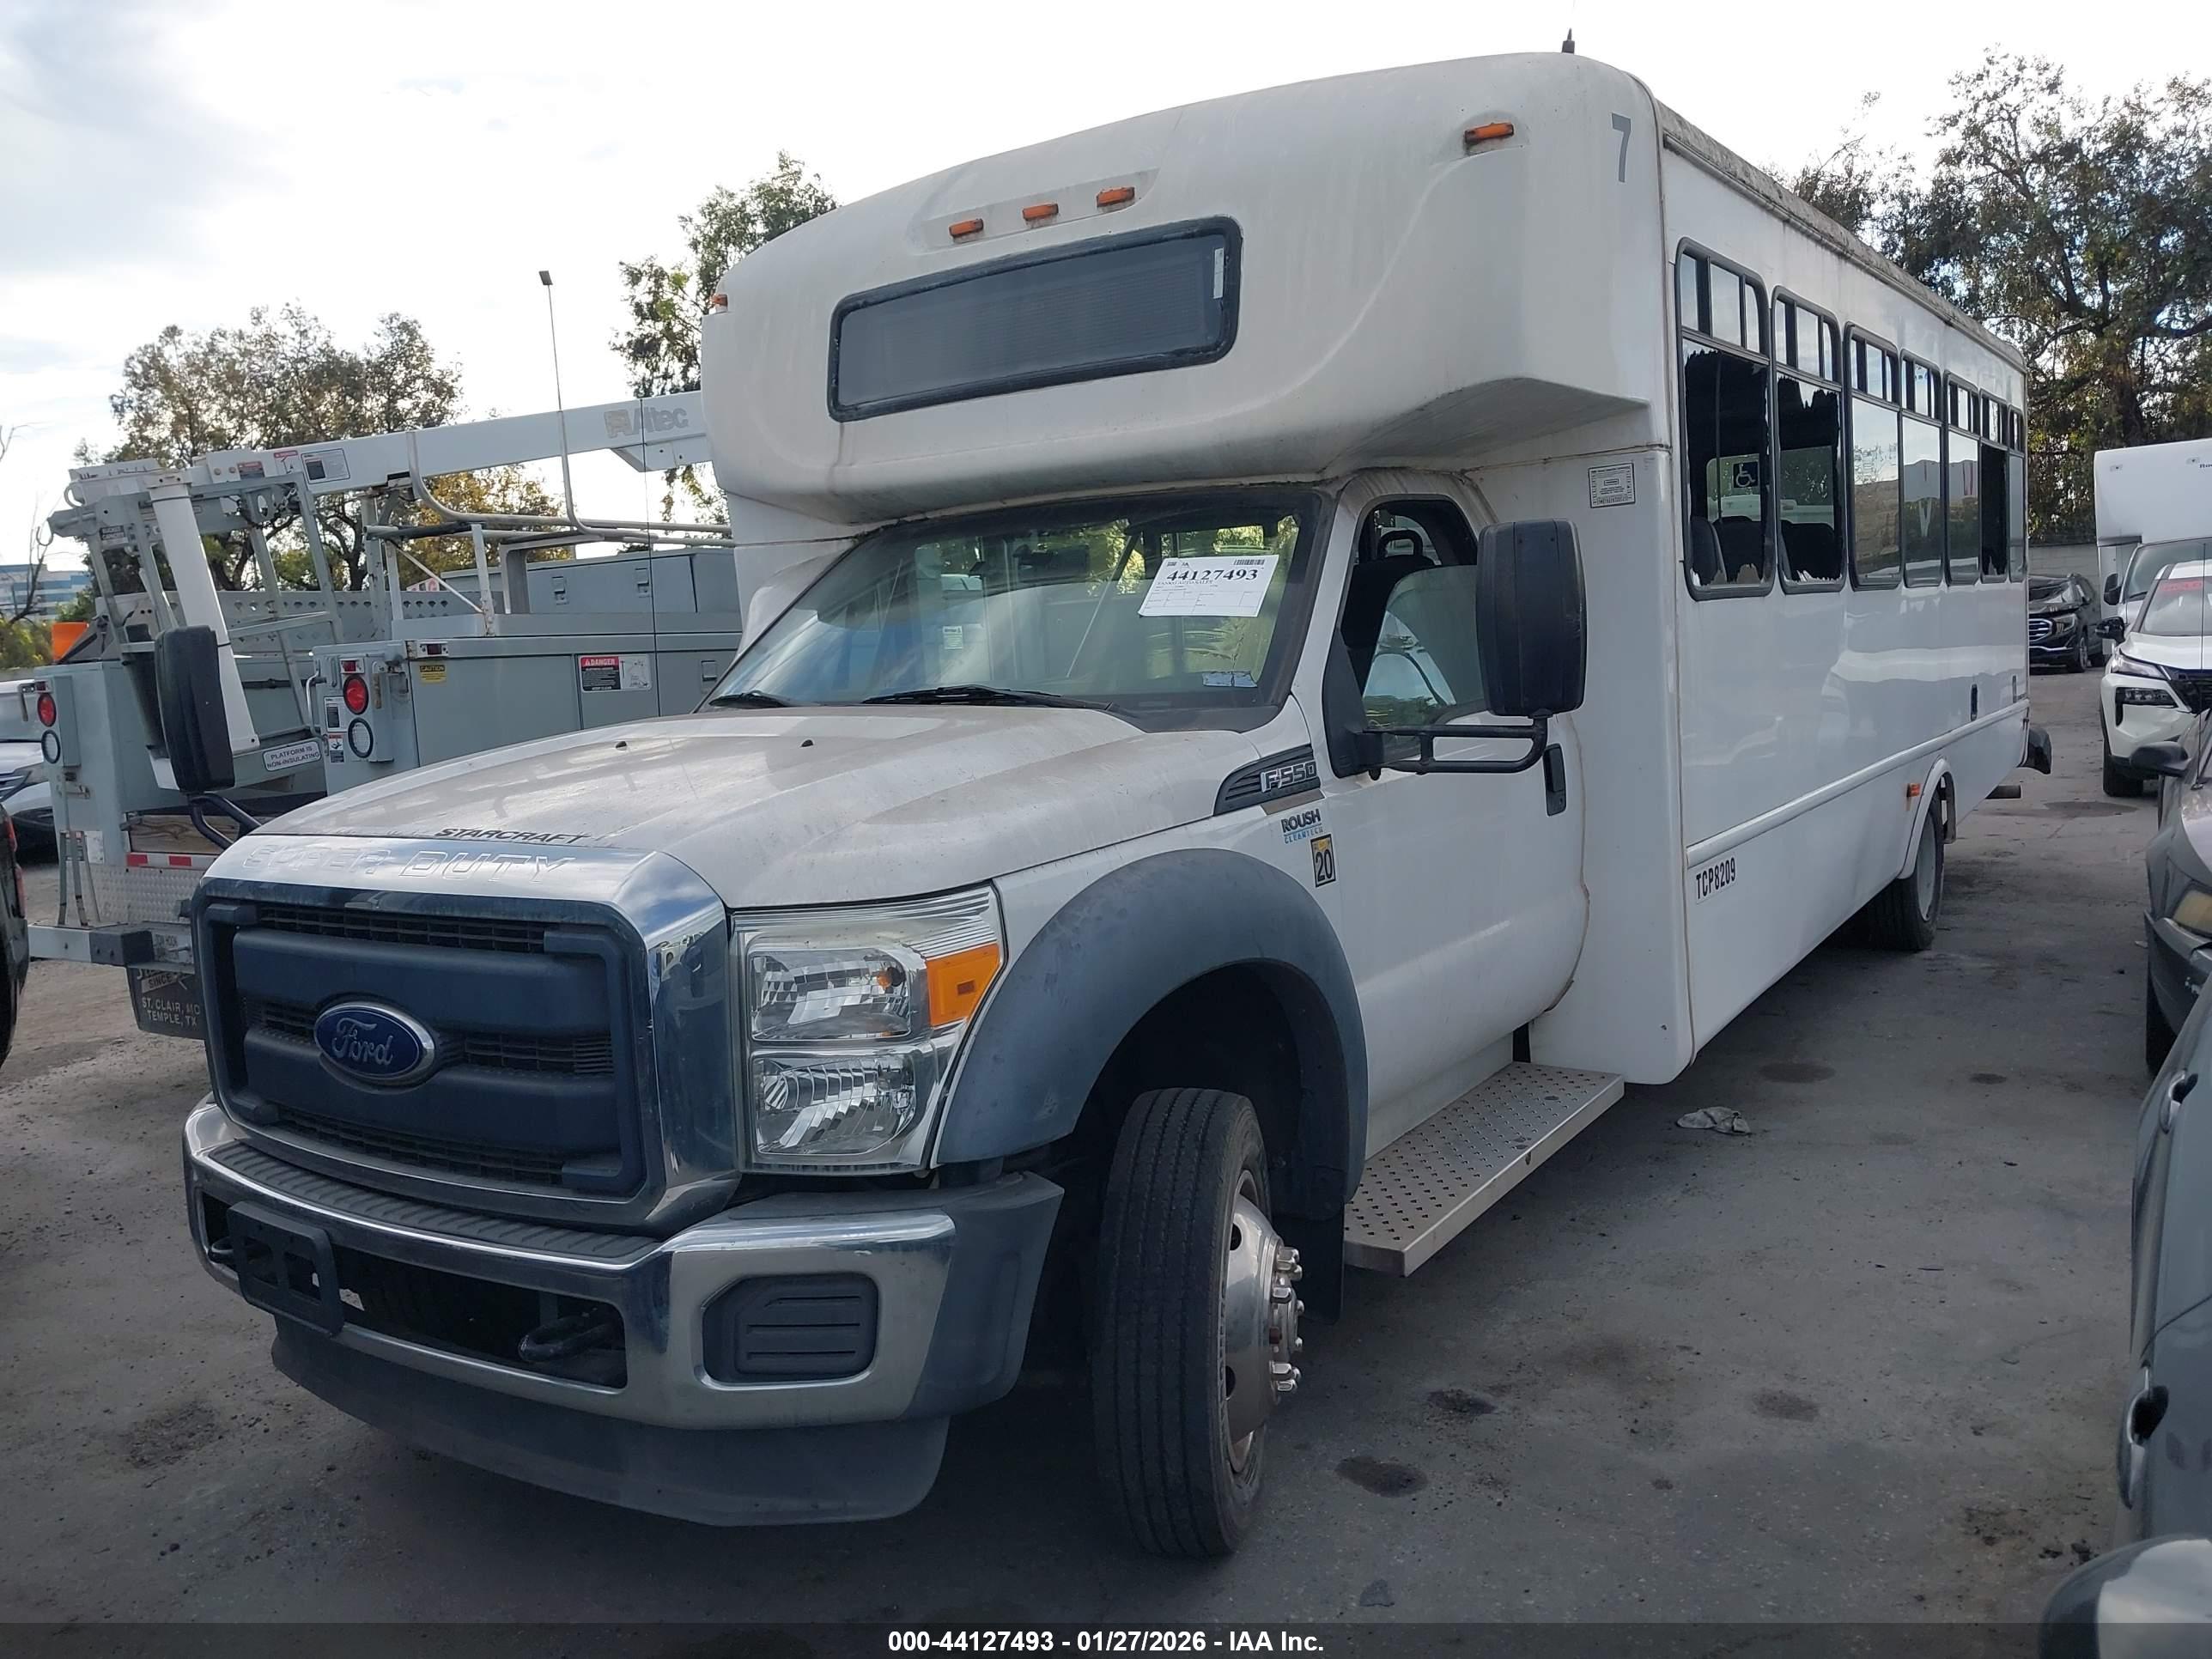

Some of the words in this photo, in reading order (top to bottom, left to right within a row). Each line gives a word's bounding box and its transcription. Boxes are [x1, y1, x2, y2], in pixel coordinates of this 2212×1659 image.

[1612, 112, 1632, 183] 7
[1167, 569, 1258, 581] 44127493
[590, 658, 616, 666] DANGER
[270, 748, 305, 760] PLATFORM
[1281, 808, 1322, 833] ROUSH
[434, 828, 591, 844] STARCRAFT
[241, 844, 392, 875] SUPER
[398, 850, 576, 883] DUTY
[1316, 848, 1333, 882] 20
[1696, 857, 1735, 900] TCP8209
[147, 1010, 183, 1027] TEMPLE,
[185, 1015, 198, 1027] TX
[331, 1018, 393, 1065] Ford
